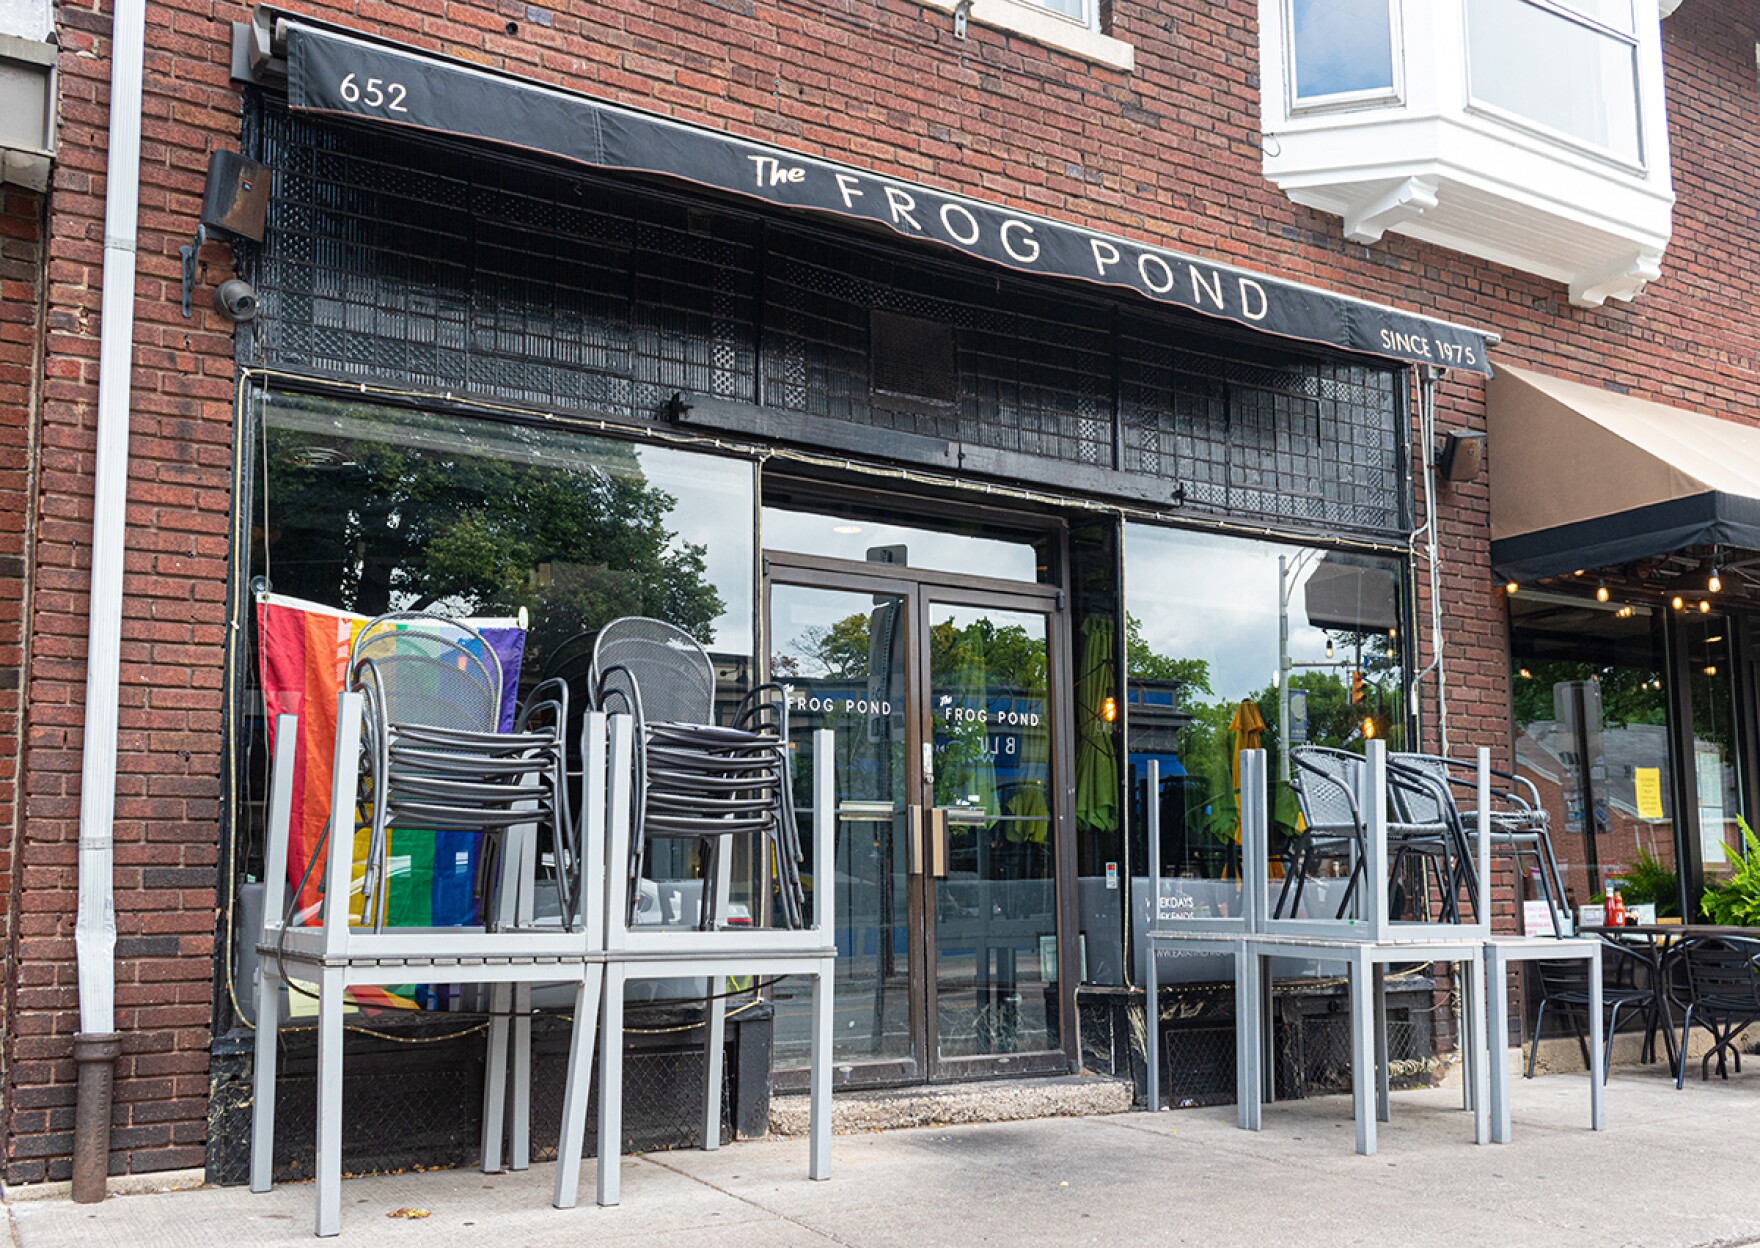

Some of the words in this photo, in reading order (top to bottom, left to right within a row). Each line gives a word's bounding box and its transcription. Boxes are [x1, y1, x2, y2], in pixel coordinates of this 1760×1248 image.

[339, 73, 408, 113] 652
[747, 155, 806, 187] The
[835, 173, 1040, 264] FROG
[1090, 239, 1267, 320] POND
[1380, 329, 1432, 357] SINCE
[1434, 340, 1476, 365] 1975
[787, 697, 834, 712] FROG
[845, 699, 891, 715] POND
[945, 707, 988, 723] FROG
[998, 711, 1039, 727] POND
